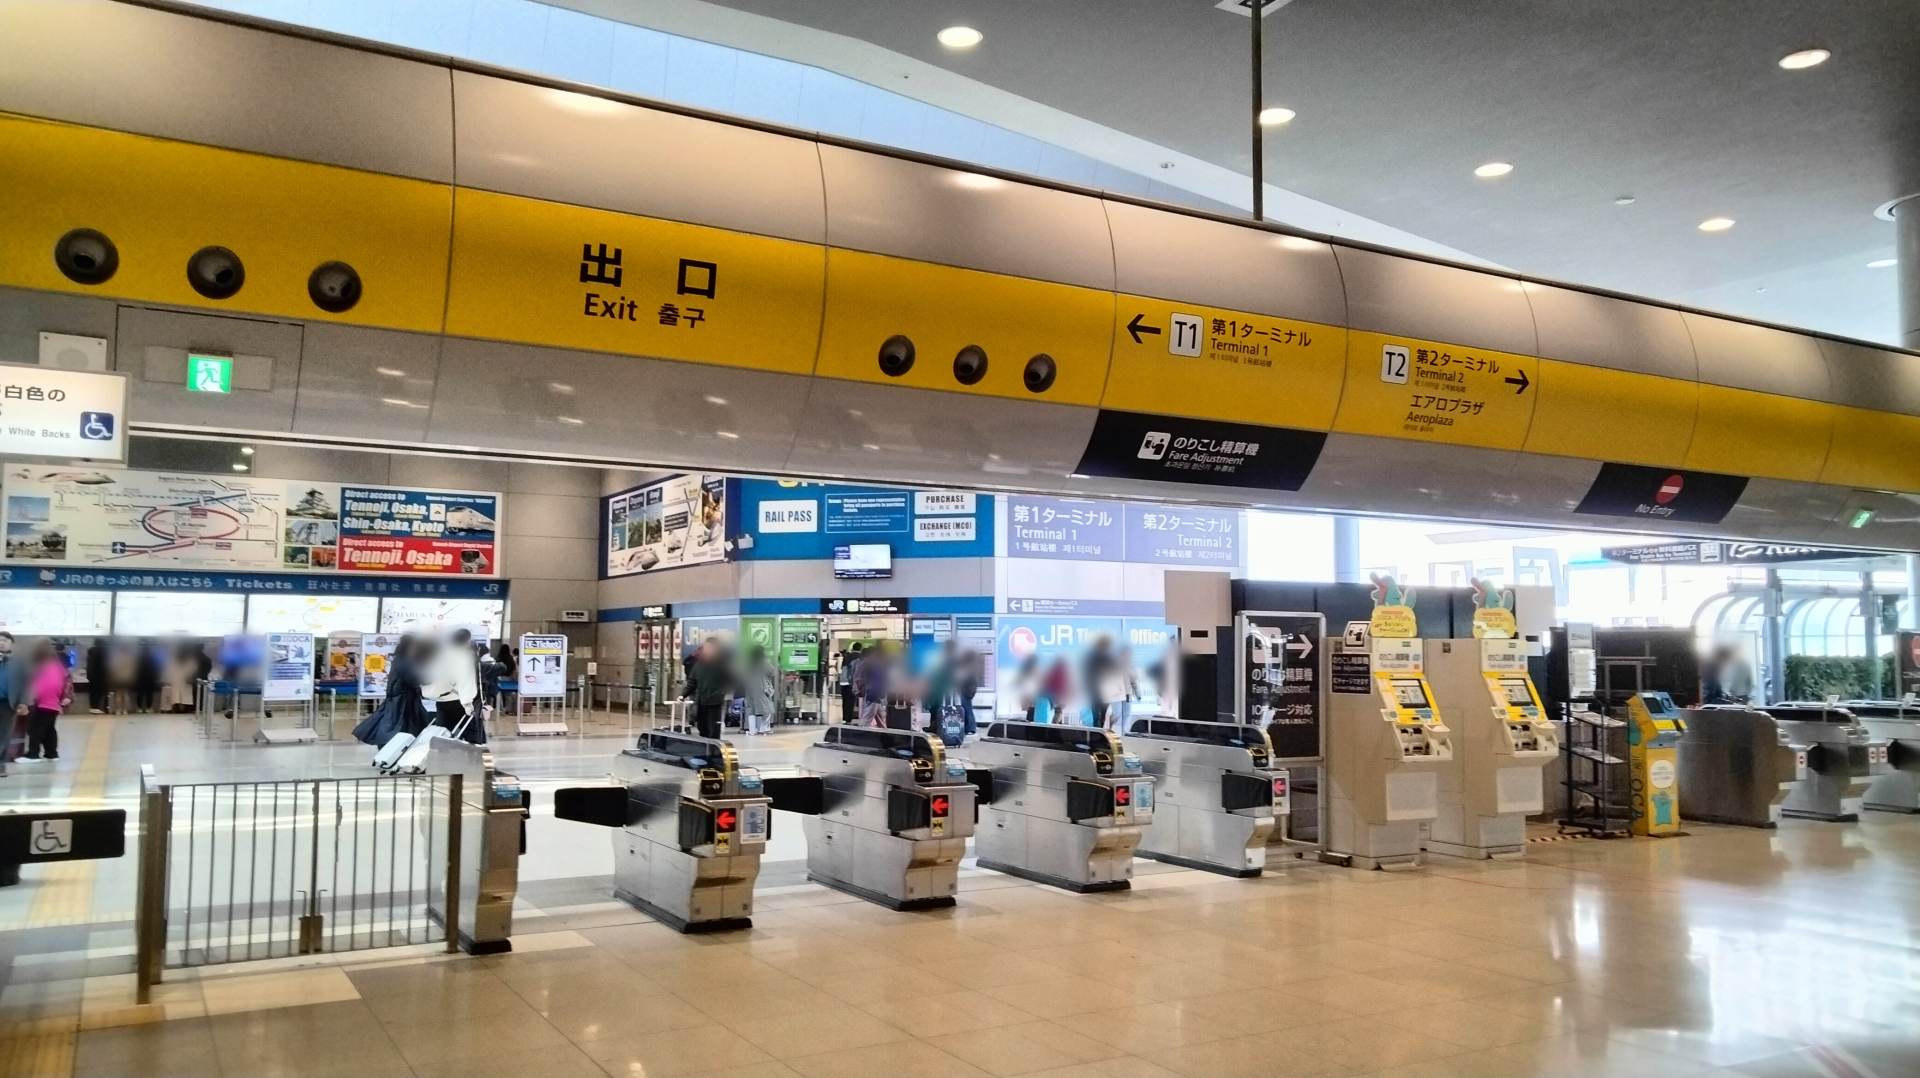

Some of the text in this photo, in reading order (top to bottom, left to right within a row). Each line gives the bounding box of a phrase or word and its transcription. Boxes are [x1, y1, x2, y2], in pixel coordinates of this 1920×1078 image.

[584, 292, 638, 321] Exit
[658, 303, 706, 328] 출구
[1175, 321, 1197, 349] T1
[1211, 318, 1312, 347] 第1ターミナル
[1211, 338, 1269, 357] Terminal 1
[1385, 351, 1406, 377] T2
[1416, 348, 1500, 374] 第2ターミナル
[1415, 366, 1464, 383] Terminal 2
[0, 385, 66, 402] 白色の
[1410, 394, 1485, 415] エアロプラザ
[1406, 411, 1454, 426] Aeroplaza
[8, 427, 70, 439] White Backs
[1173, 436, 1260, 456] のりこし精算機
[1168, 450, 1244, 466] Fare Adjustment
[344, 489, 406, 501] Direct access to
[926, 495, 964, 503] PURCHASE
[345, 500, 429, 516] Tennoji, Osaka,
[1014, 505, 1113, 527] 第1ターミナル
[1635, 504, 1676, 517] No Entry
[342, 516, 445, 533] Shin-Osaka, Kyoto
[765, 510, 812, 523] RAIL PASS
[1143, 513, 1232, 533] 第2ターミナル
[920, 522, 951, 530] EXCHANGE
[1014, 525, 1077, 541] Terminal 1
[342, 538, 367, 547] Direct
[367, 540, 395, 548] access
[1177, 533, 1232, 549] Terminal 2
[343, 547, 454, 566] Tennoji, Osaka
[225, 578, 293, 590] Tickets
[483, 583, 499, 594] JR
[828, 600, 845, 611] JR
[282, 635, 310, 643] ICOCA
[1041, 625, 1073, 646] JR
[1252, 684, 1310, 696] Fare Adjustment
